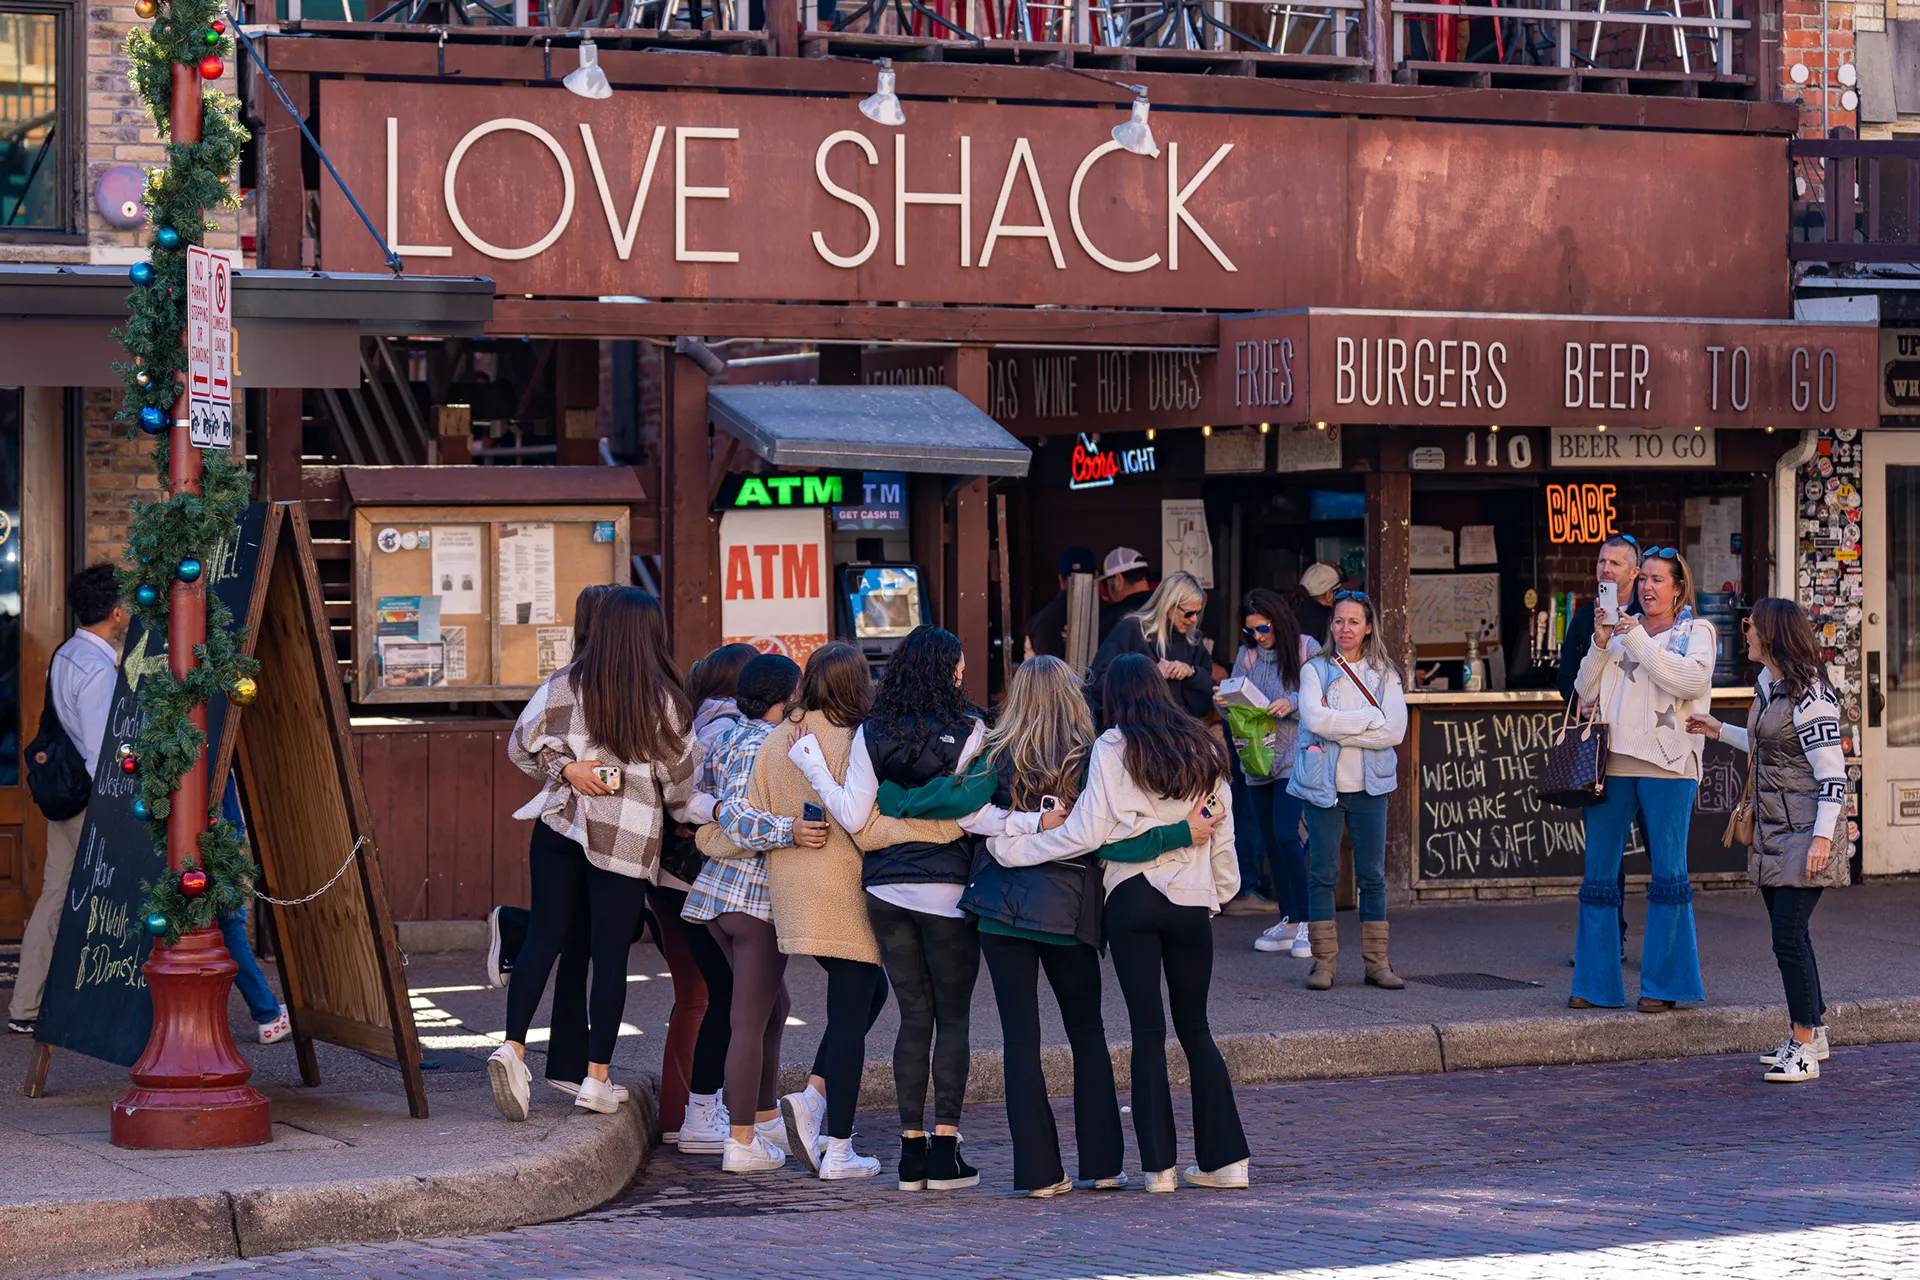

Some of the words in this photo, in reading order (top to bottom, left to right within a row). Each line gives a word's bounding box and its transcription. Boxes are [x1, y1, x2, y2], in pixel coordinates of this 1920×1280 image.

[387, 117, 740, 262] LOVE
[812, 129, 1238, 273] SHACK
[194, 259, 203, 281] NO
[191, 284, 208, 303] PARKING
[191, 304, 209, 323] STOPPING
[197, 325, 203, 342] OR
[191, 345, 209, 364] STANDING
[1033, 356, 1079, 417] WINE
[1097, 350, 1133, 414] HOT
[1150, 348, 1201, 412] DOGS
[1235, 337, 1294, 408] FRIES
[1336, 336, 1507, 408] BURGERS
[1565, 342, 1650, 410] BEER
[1706, 346, 1751, 411] TO
[1791, 347, 1837, 413] GO
[1071, 444, 1119, 482] Coors
[1464, 432, 1532, 469] 110
[1559, 434, 1621, 458] BEER
[1629, 434, 1663, 458] TO
[1672, 434, 1706, 459] GO
[734, 476, 843, 506] ATM
[862, 483, 900, 504] TM
[839, 510, 858, 519] GET
[860, 510, 887, 520] CASH
[1546, 483, 1619, 544] BABE
[725, 543, 820, 600] ATM
[1433, 718, 1487, 760] THE
[1492, 712, 1562, 756] MORE
[1422, 759, 1487, 792] WEIGH
[1492, 752, 1540, 781] THE
[1424, 800, 1464, 830] YOU
[1467, 791, 1506, 821] ARE
[1424, 827, 1482, 878] STAY
[1541, 818, 1586, 858] DRIN
